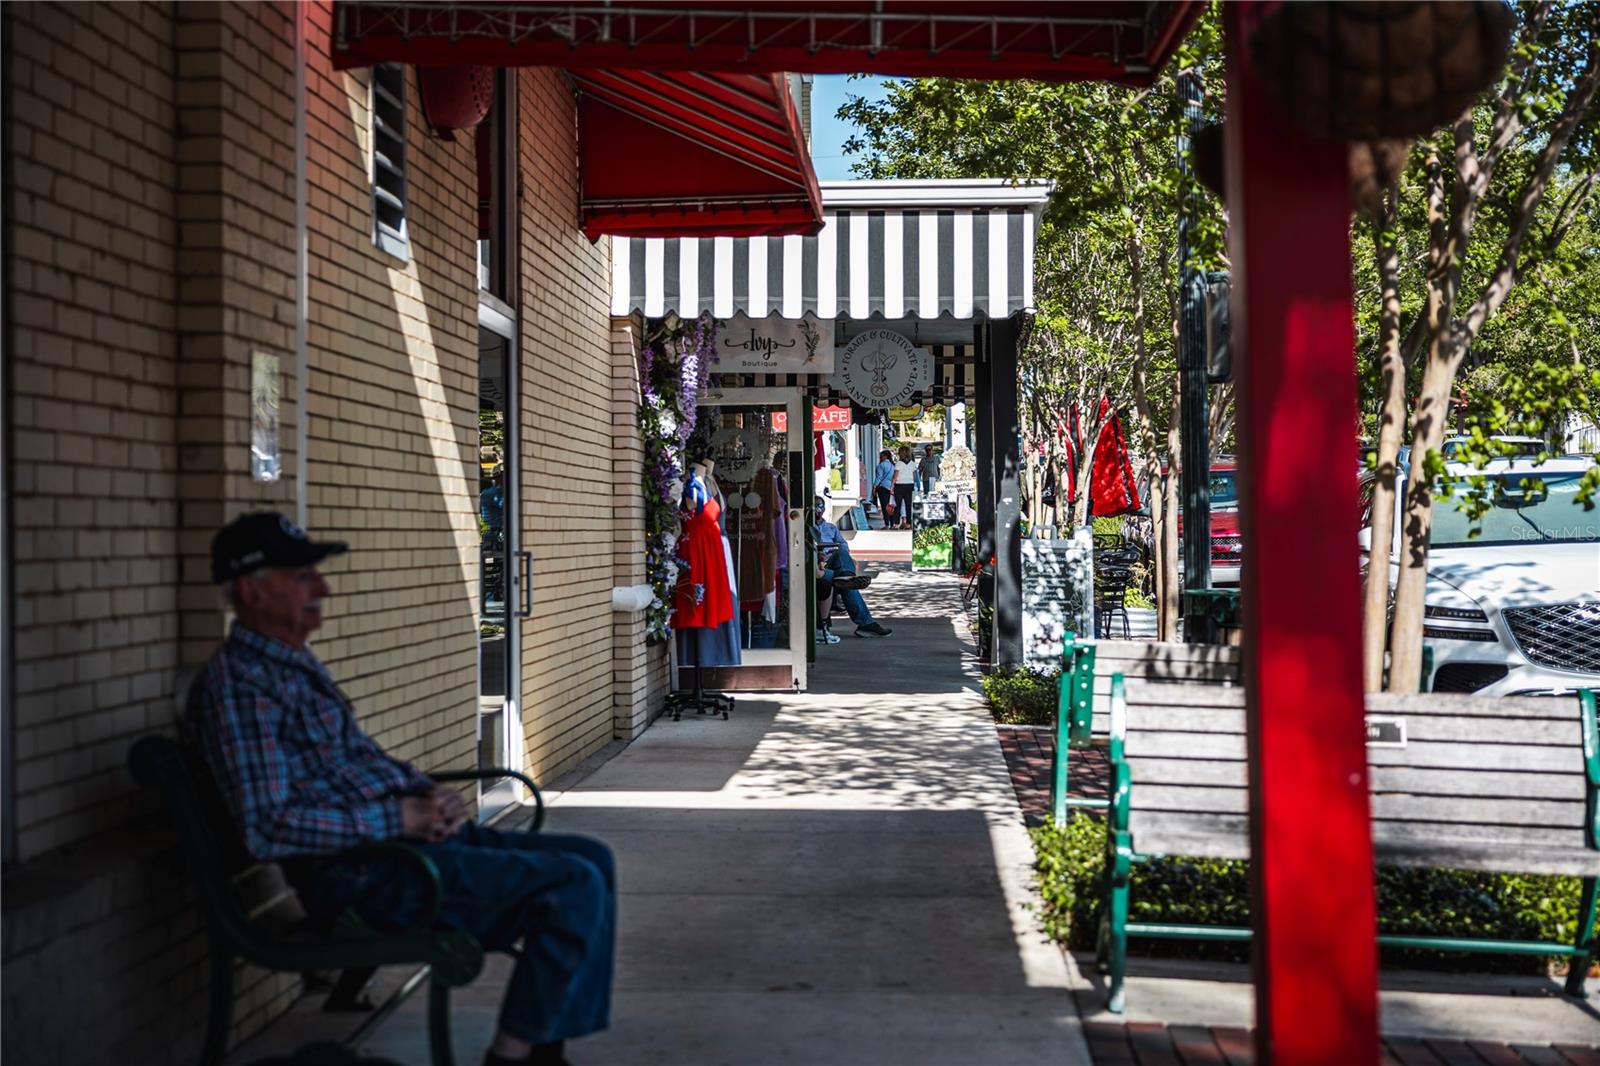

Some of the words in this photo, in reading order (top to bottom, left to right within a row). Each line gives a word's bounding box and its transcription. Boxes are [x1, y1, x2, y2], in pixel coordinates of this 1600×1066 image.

[742, 328, 779, 360] Ivy
[842, 334, 868, 364] FORAGE
[869, 330, 878, 339] &
[879, 330, 918, 366] CULTIVATE
[842, 373, 868, 404] PLANT
[870, 372, 918, 407] BOUTIQUE
